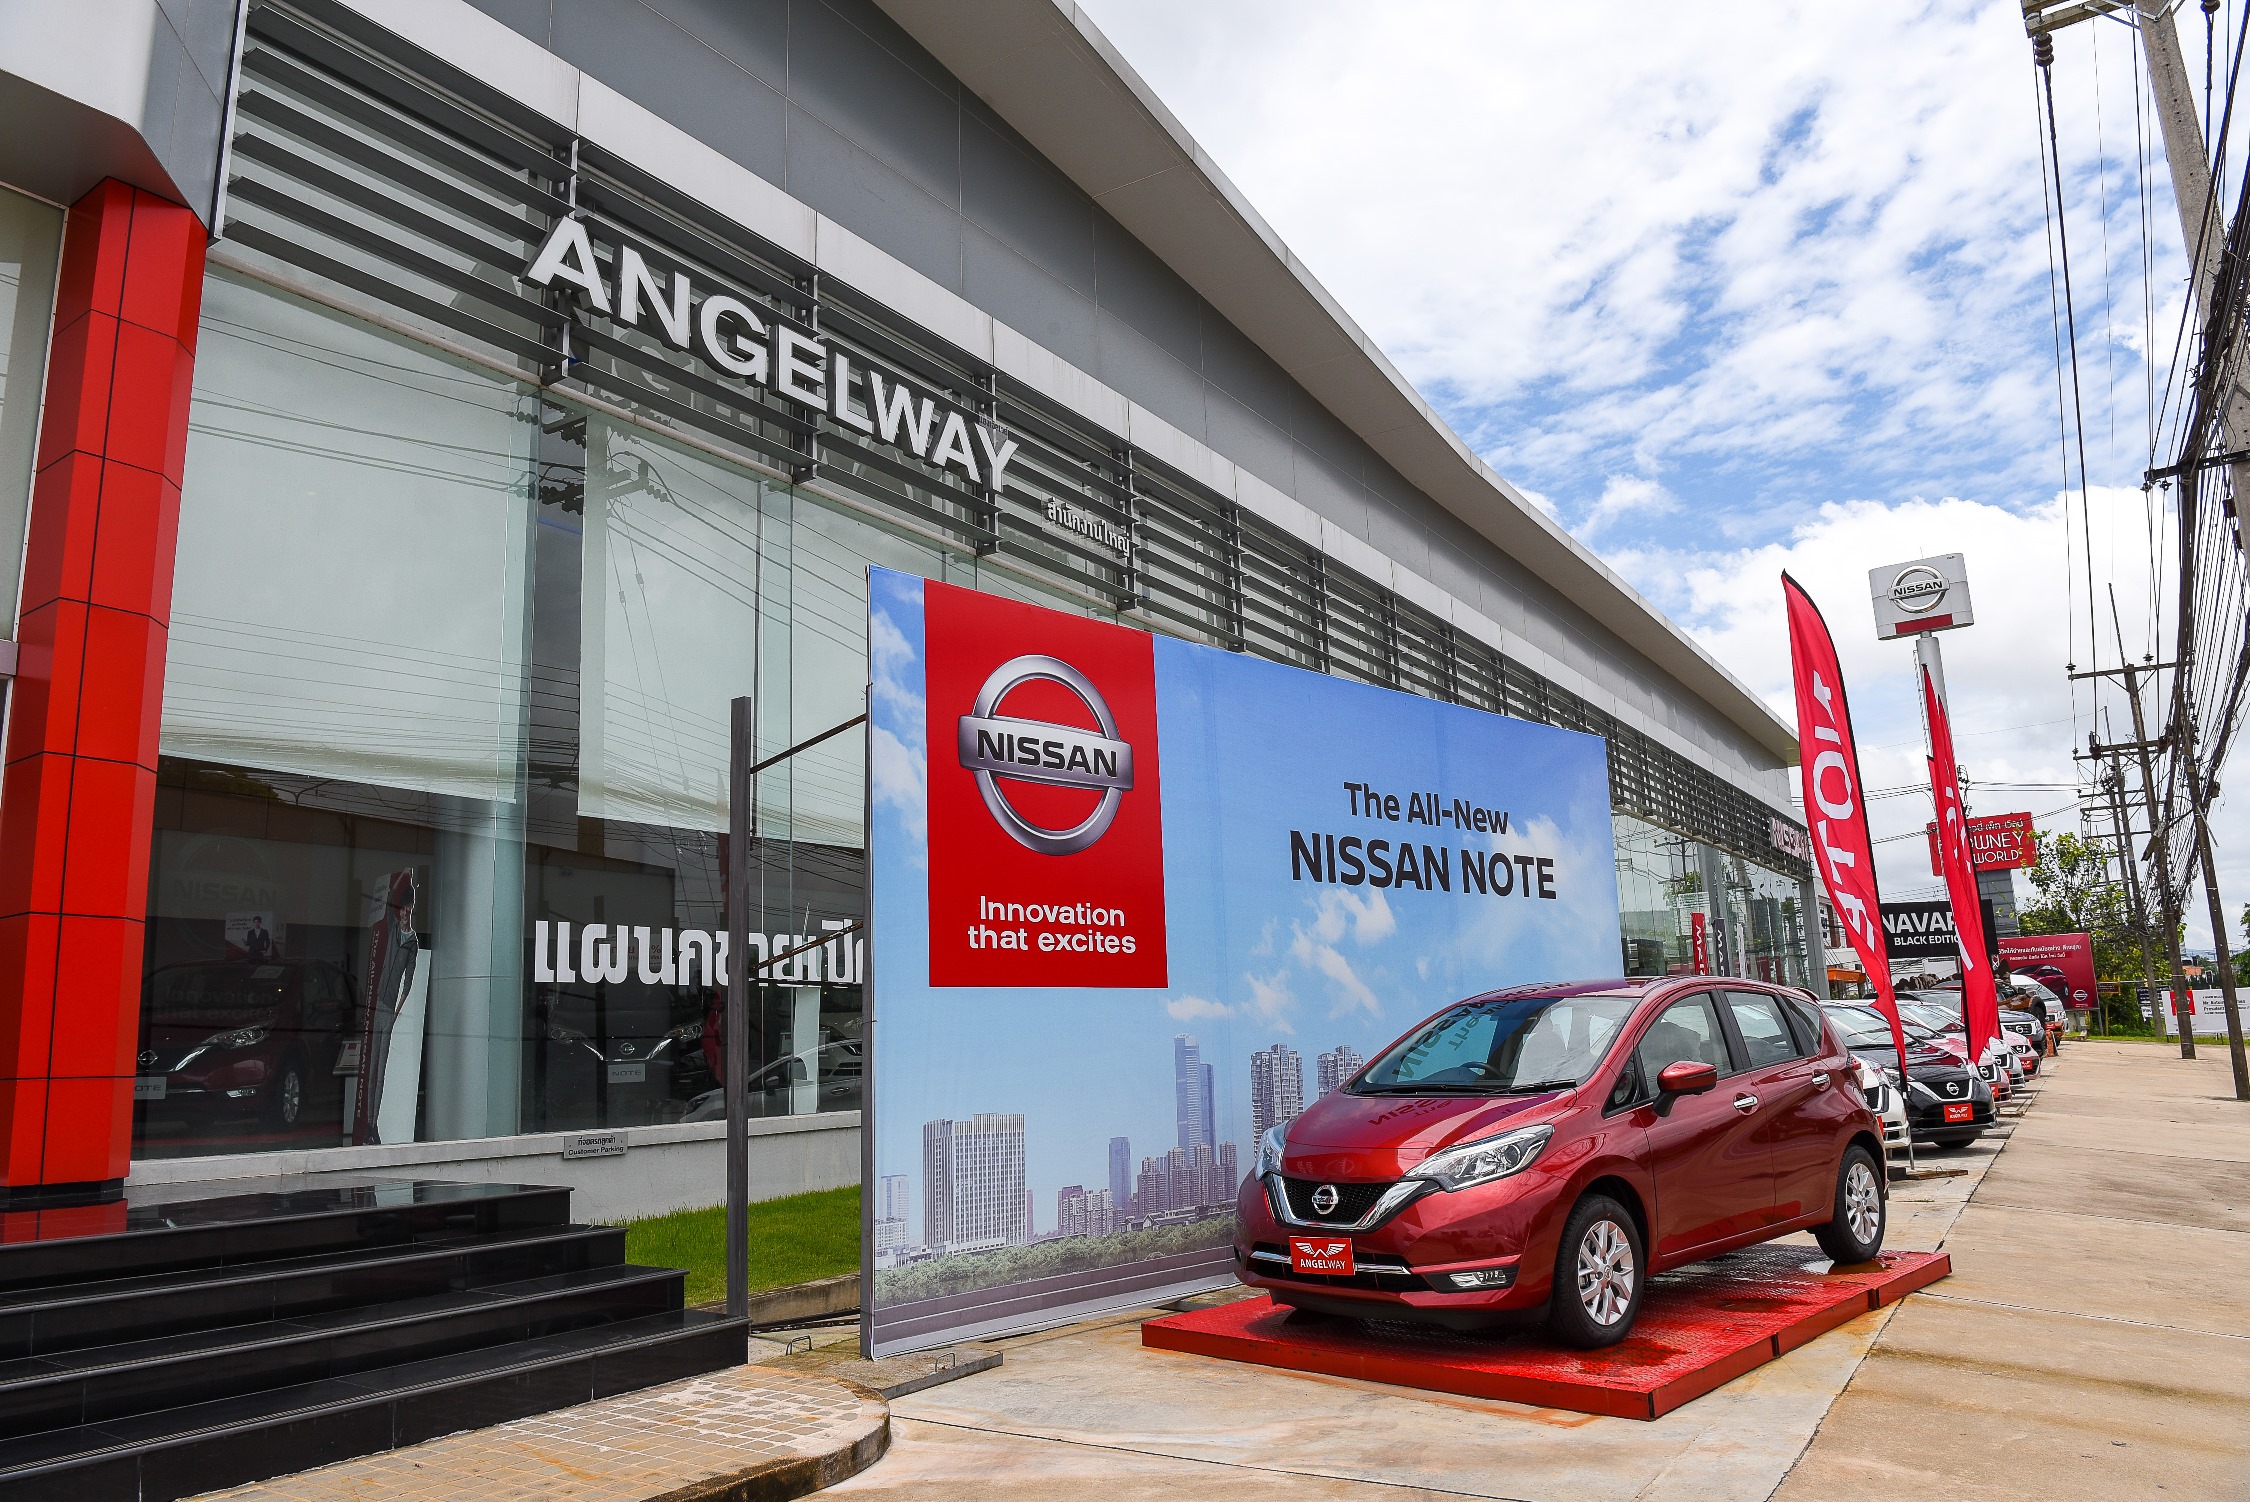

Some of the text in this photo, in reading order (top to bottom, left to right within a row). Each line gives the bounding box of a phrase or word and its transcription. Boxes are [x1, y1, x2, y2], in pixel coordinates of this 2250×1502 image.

[519, 216, 1019, 494] ANGELWAY
[1893, 580, 1943, 597] NISSAN
[977, 728, 1118, 779] NISSAN
[1343, 781, 1509, 835] The All-New
[1290, 830, 1557, 900] NISSAN NOTE
[1973, 849, 2020, 864] WORLD
[979, 895, 1126, 927] Innovation
[967, 924, 1137, 954] that excites
[1894, 935, 1928, 946] BLACK
[611, 1069, 642, 1079] NOTE
[600, 1145, 624, 1153] Parking
[1300, 1258, 1346, 1270] ANGELWAY
